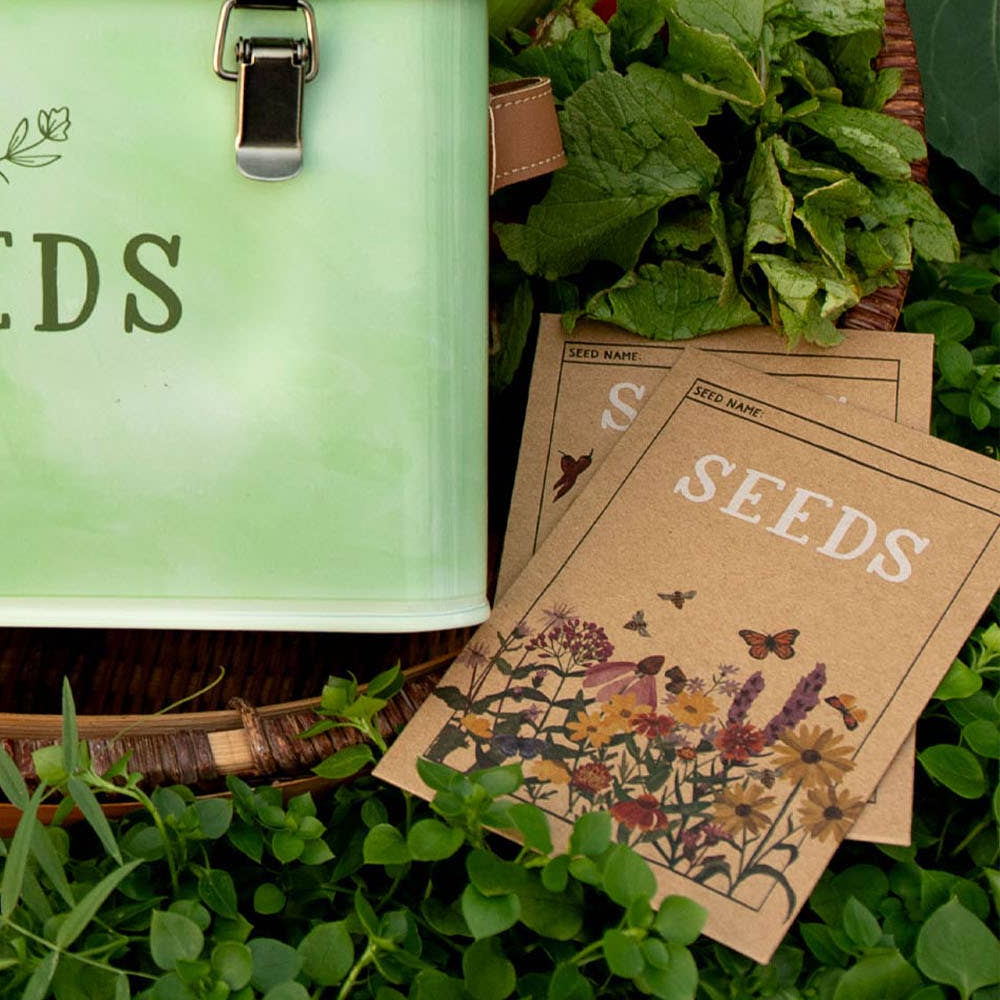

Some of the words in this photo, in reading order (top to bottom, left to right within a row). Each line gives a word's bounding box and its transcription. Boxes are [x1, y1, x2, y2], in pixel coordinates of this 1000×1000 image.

[568, 347, 599, 359] SEED
[603, 350, 642, 361] NAME:
[693, 386, 724, 403] SEED
[726, 398, 765, 419] NAME:
[673, 454, 930, 584] SEEDS
